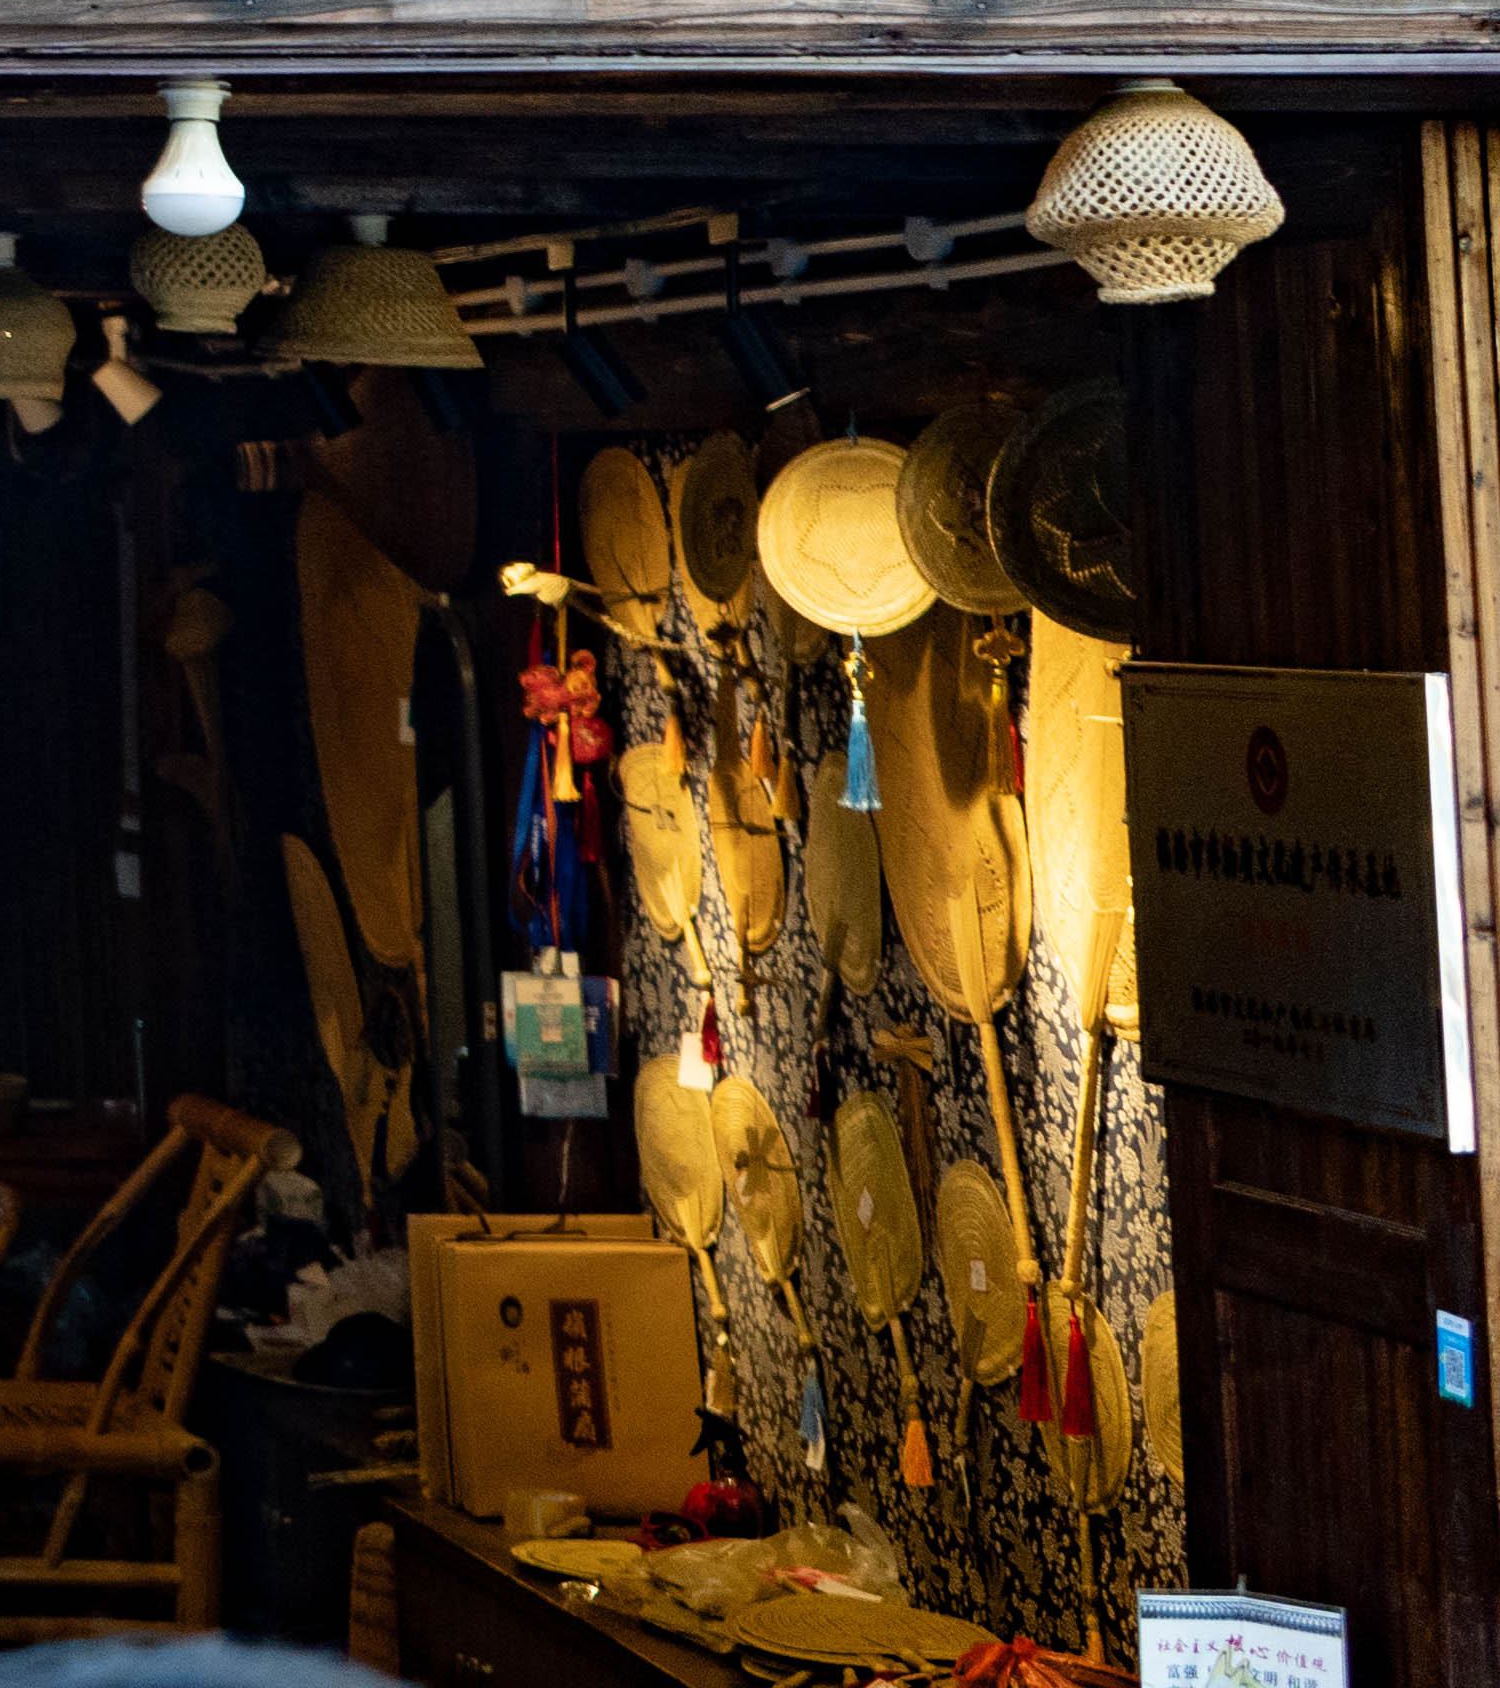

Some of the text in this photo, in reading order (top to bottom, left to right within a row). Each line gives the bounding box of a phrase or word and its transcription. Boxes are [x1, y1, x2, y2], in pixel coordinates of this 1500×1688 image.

[1157, 1634, 1331, 1673] 社会主义核心价值观
